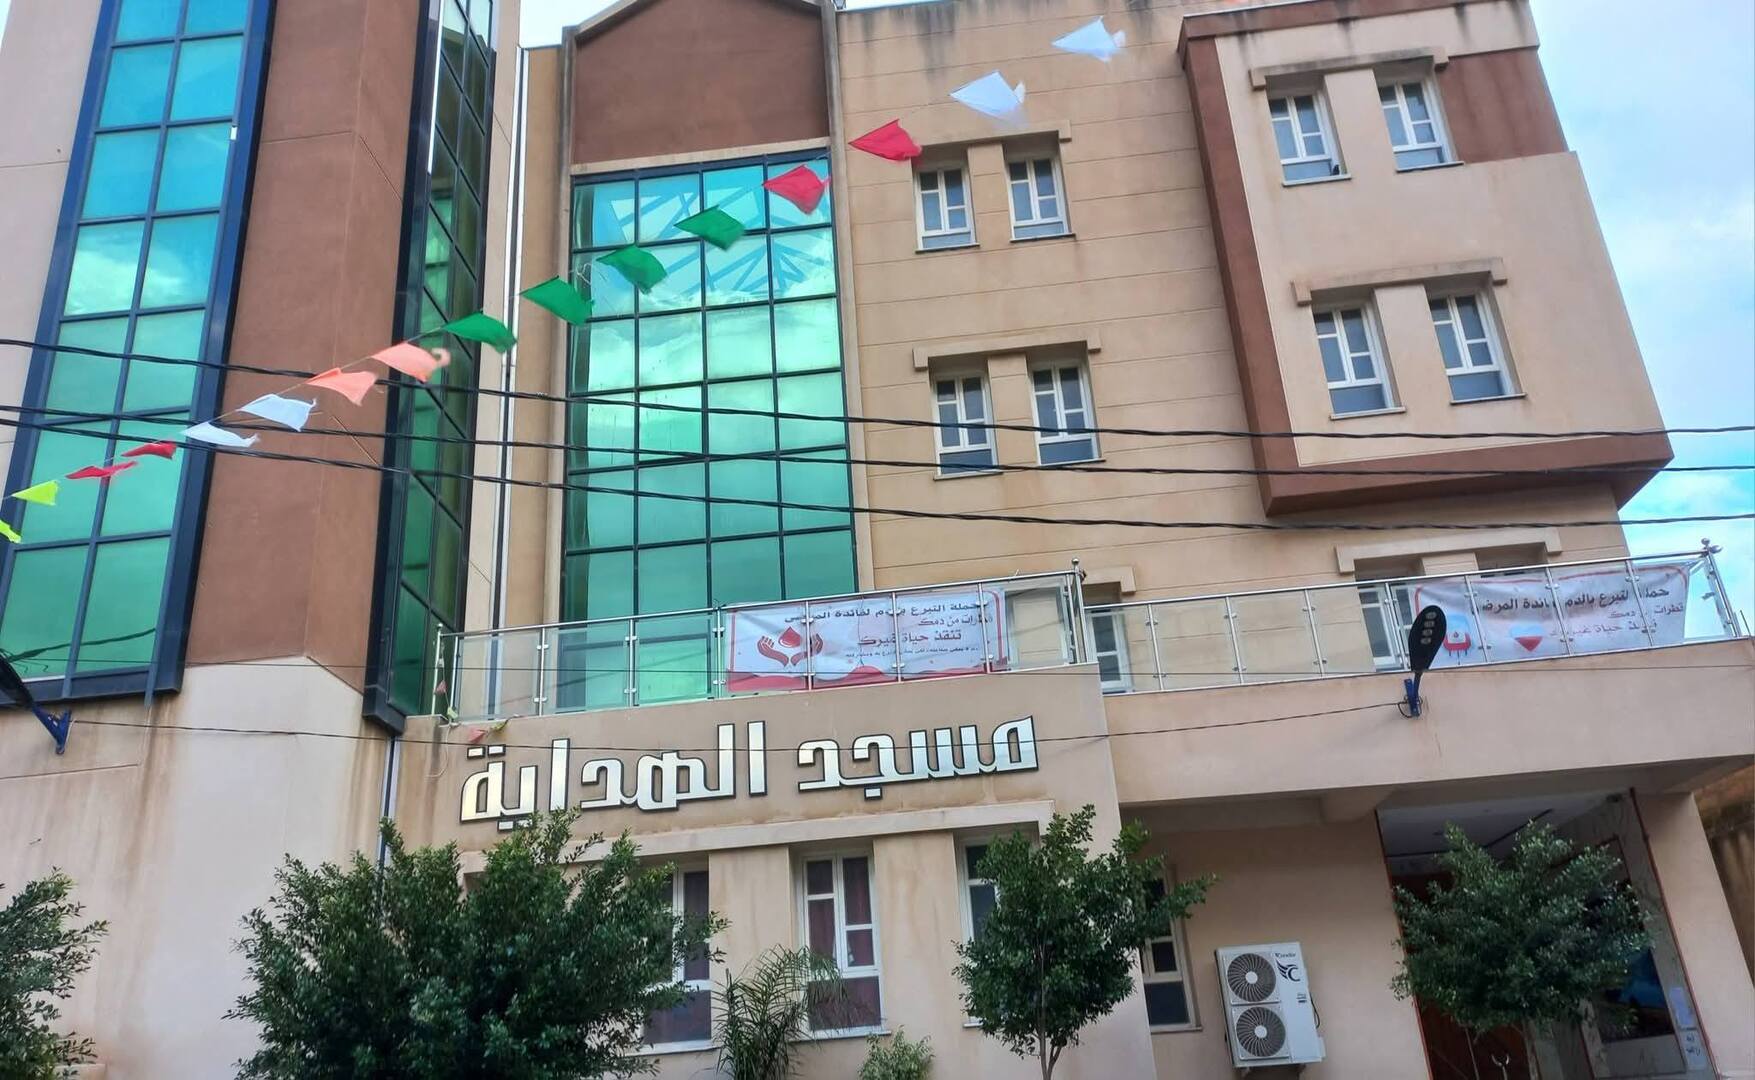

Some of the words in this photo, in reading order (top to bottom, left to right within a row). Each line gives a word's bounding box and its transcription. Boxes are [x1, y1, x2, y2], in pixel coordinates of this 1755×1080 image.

[1565, 593, 1595, 608] بالدم
[911, 604, 945, 616] التبرع
[902, 632, 929, 645] حياة
[934, 629, 962, 641] تنقذ
[797, 714, 1039, 799] مسجد
[460, 720, 767, 831] الهداية
